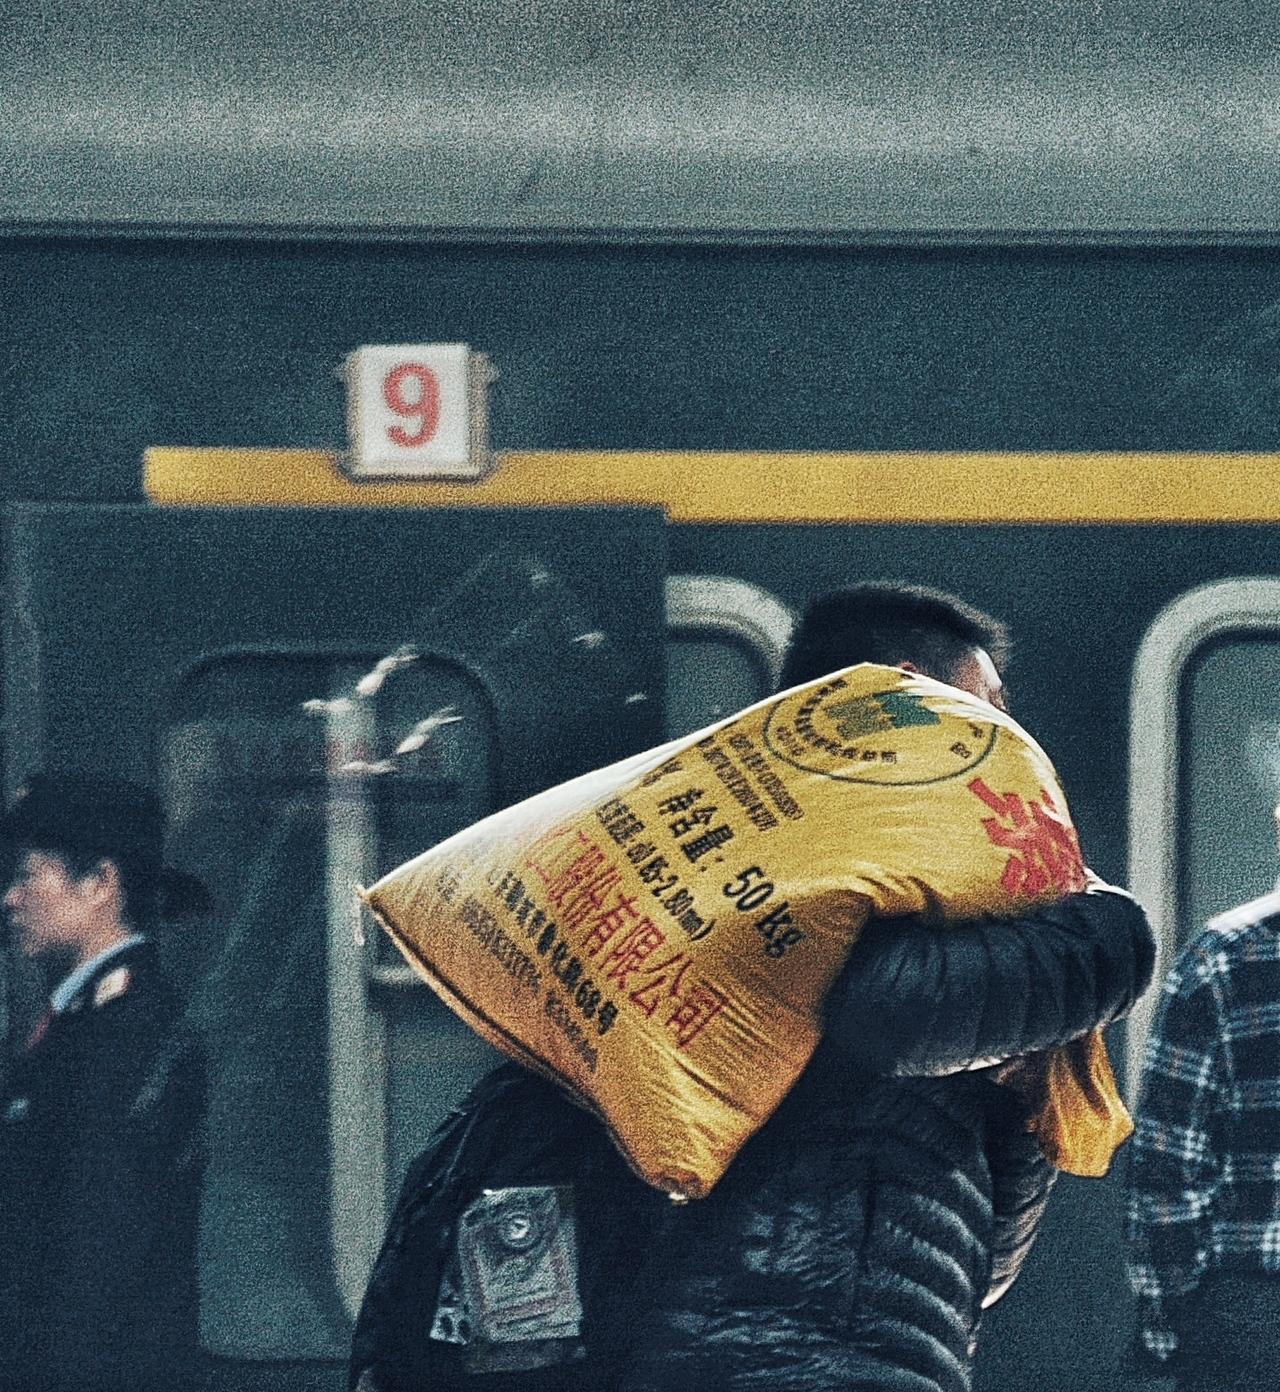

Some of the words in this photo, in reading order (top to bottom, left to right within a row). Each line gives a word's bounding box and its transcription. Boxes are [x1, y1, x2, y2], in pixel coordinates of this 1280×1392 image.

[383, 361, 441, 448] 9
[722, 865, 775, 912] 50
[754, 900, 803, 959] kg
